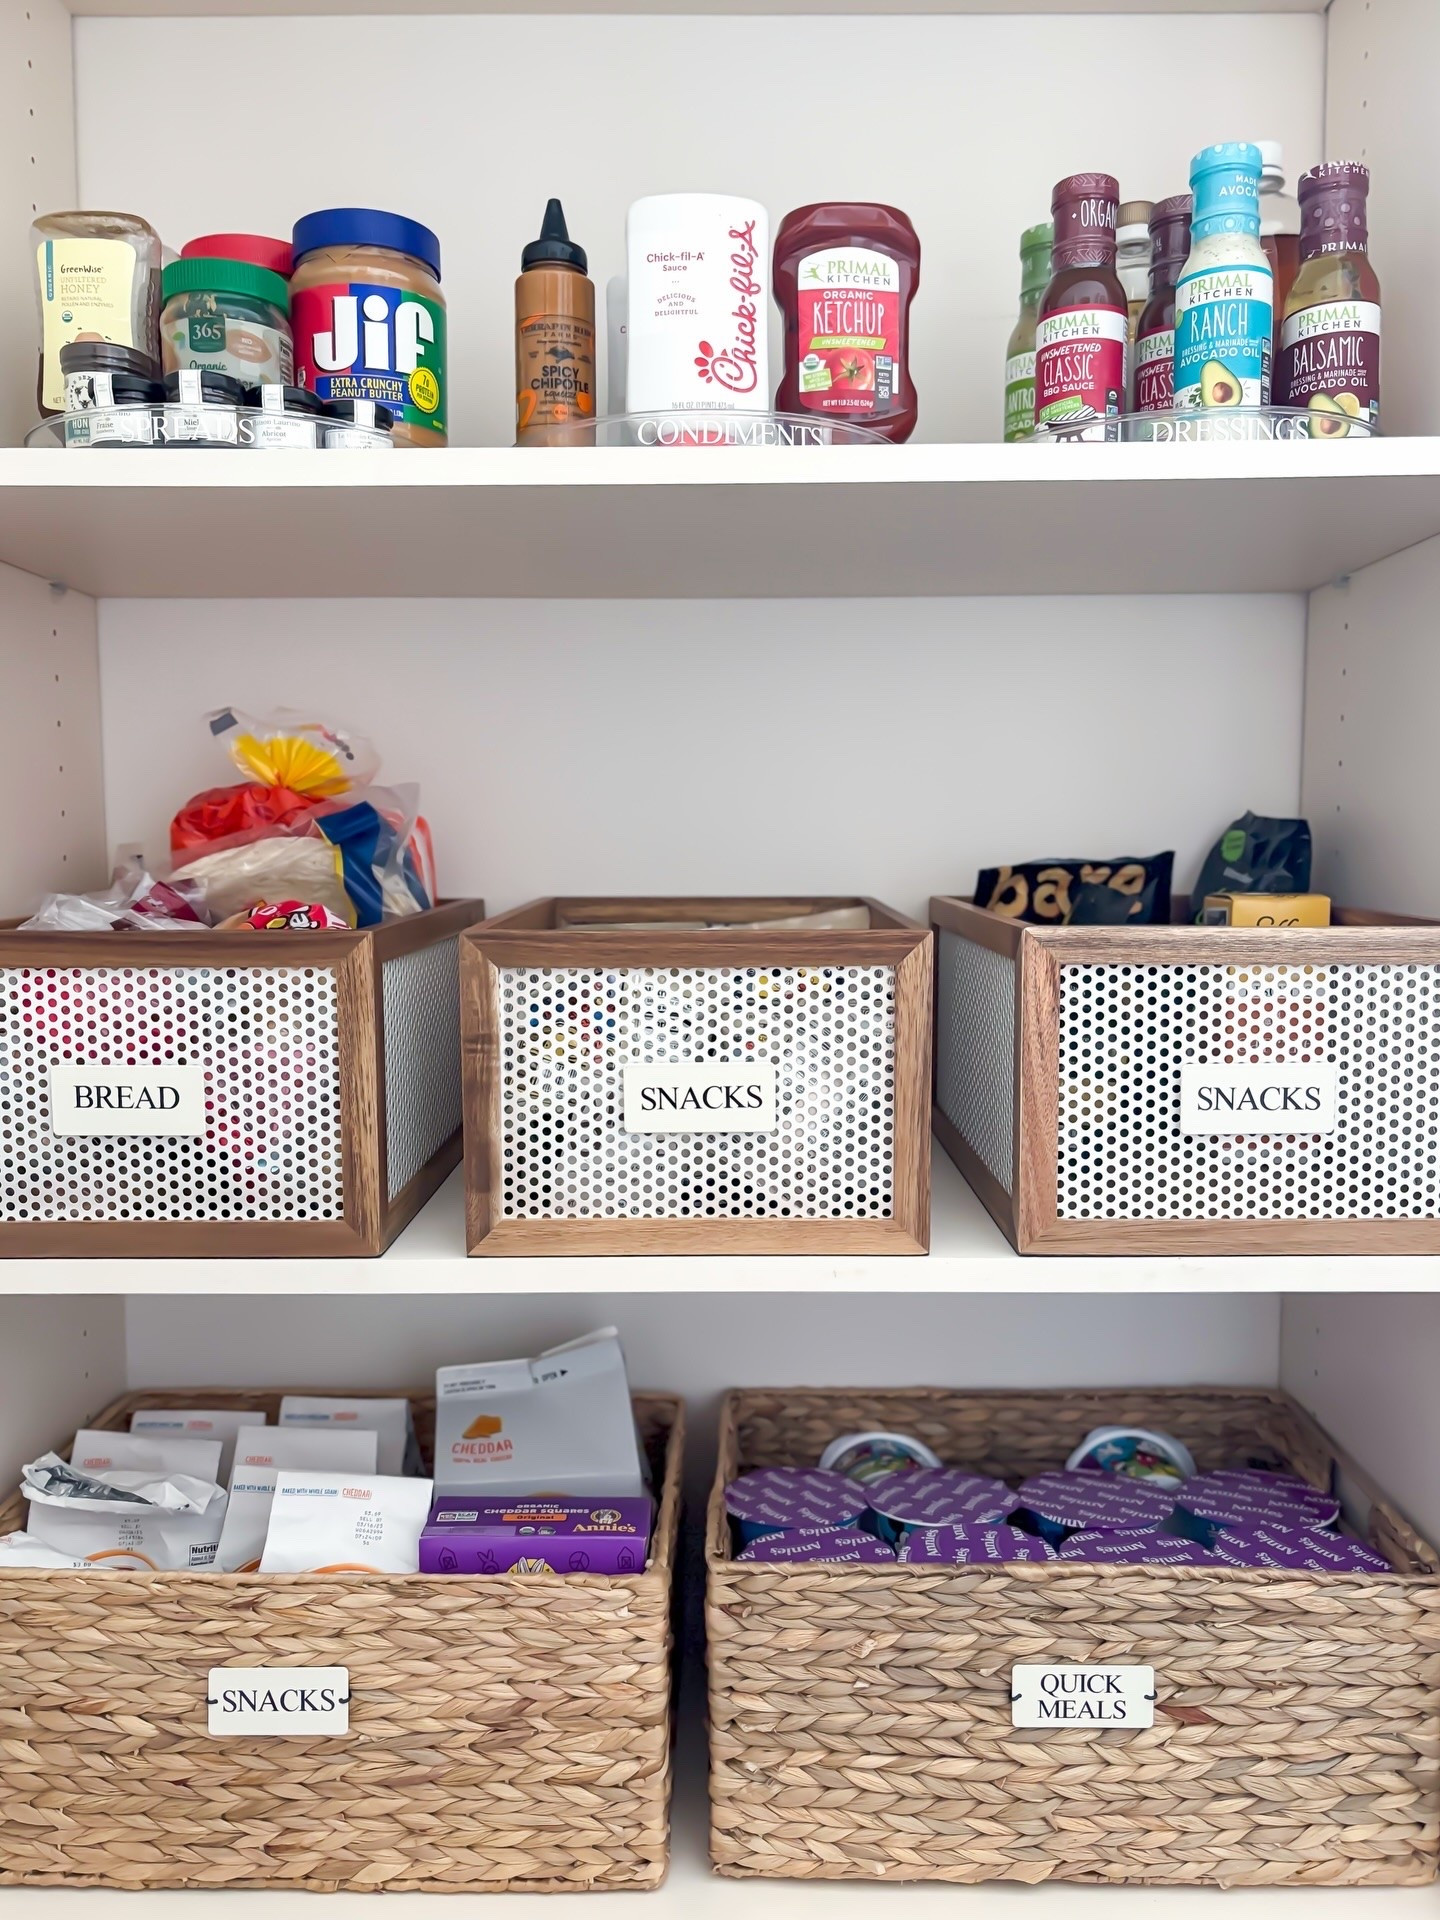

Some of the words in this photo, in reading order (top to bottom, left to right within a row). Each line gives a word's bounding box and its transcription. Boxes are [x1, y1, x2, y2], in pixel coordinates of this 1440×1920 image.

[1236, 175, 1257, 187] MADE
[646, 251, 705, 263] Chick-fil-A
[60, 264, 104, 274] GreenWise
[662, 264, 688, 272] Sauce
[827, 260, 890, 277] PRIMAL
[60, 276, 107, 285] UNFILTERED
[827, 274, 891, 286] KITCHEN
[1190, 273, 1253, 296] PRIMAL
[61, 284, 100, 294] HONEY
[823, 290, 874, 301] ORGANIC
[1190, 287, 1254, 305] KITCHEN
[657, 293, 696, 304] DELICIOUS
[654, 309, 699, 317] DELIGHTFUL
[812, 301, 885, 335] KETCHUP
[1297, 305, 1362, 330] PRIMAL
[1042, 313, 1100, 336] PRIMAL
[1190, 303, 1249, 343] RANCH
[1297, 320, 1363, 339] KITCHEN
[192, 323, 222, 341] 365
[313, 296, 435, 374] Jif
[1042, 326, 1101, 344] KITCHEN
[821, 338, 877, 346] UNSWEETENED
[1182, 341, 1208, 358] DRESSING
[1208, 341, 1214, 349] &
[1214, 338, 1249, 349] MARINADE
[1041, 342, 1102, 363] UNSWEETENED
[1180, 347, 1239, 369] AVOCADO
[1242, 346, 1260, 358] OIL
[1293, 336, 1364, 378] BALSAMIC
[189, 360, 227, 371] Organic
[542, 365, 580, 380] SPICY
[1044, 353, 1095, 388] CLASSIC
[330, 377, 358, 389] EXTRA
[360, 378, 404, 392] CRUNCHY
[531, 378, 589, 394] CHIPOTLE
[1290, 373, 1316, 389] DRESSING
[1317, 372, 1323, 380] &
[1323, 368, 1358, 379] MARINADE
[330, 388, 367, 398] PEANUT
[369, 390, 404, 402] BUTTER
[415, 384, 435, 399] PROTEIN
[1043, 386, 1060, 398] BBQ
[1062, 381, 1096, 393] SAUCE
[1289, 377, 1347, 400] AVOCADO
[1350, 377, 1369, 387] OIL
[822, 399, 831, 407] NET
[120, 416, 258, 445] SPREADS
[183, 418, 200, 427] Miel
[1150, 416, 1310, 442] DRESSINGS
[637, 418, 823, 446] CONDIMENTS
[73, 1085, 181, 1111] BREAD
[640, 1084, 764, 1112] SNACKS
[1197, 1086, 1322, 1112] SNACKS
[451, 1439, 513, 1456] CHEDDAR
[233, 1484, 246, 1492] BAKED
[246, 1484, 257, 1492] WITH
[281, 1487, 295, 1495] BAKED
[296, 1487, 308, 1495] WITH
[572, 1523, 637, 1533] Annie's
[1096, 1541, 1147, 1555] Annie's
[1039, 1673, 1125, 1698] QUICK
[222, 1688, 336, 1713] SNACKS
[1036, 1699, 1127, 1720] MEALS
